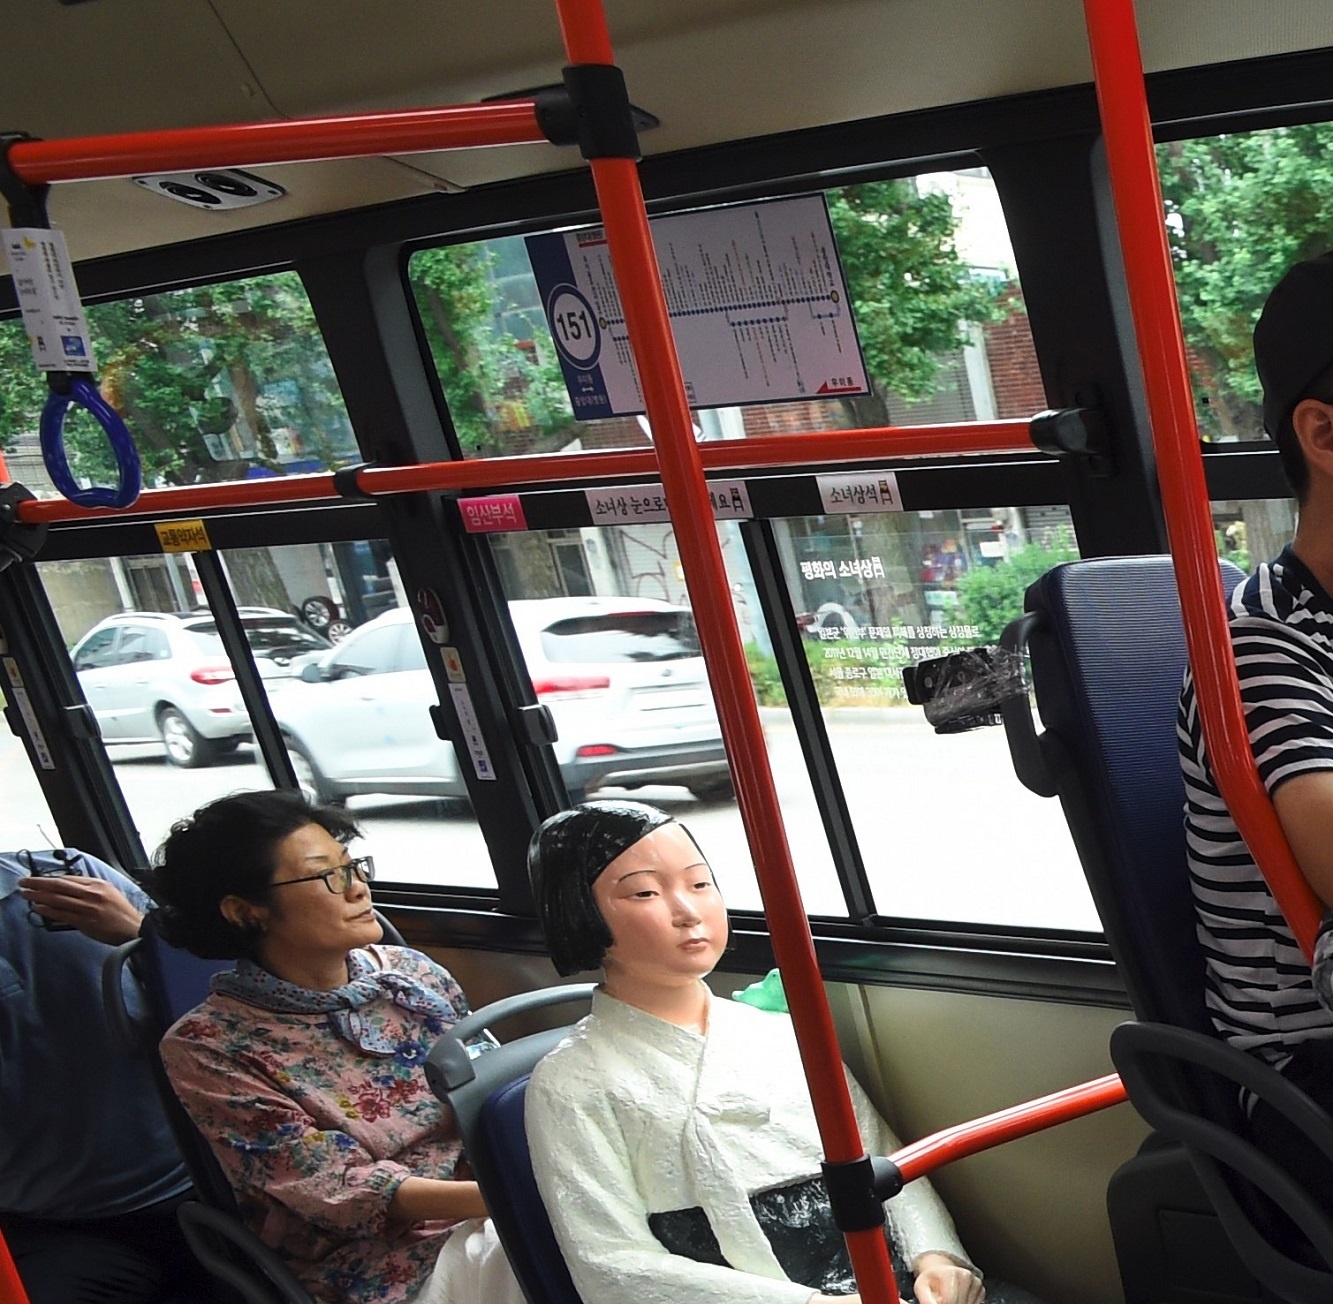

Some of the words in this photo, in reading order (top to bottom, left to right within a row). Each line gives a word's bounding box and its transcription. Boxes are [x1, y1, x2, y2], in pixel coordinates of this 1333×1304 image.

[557, 310, 592, 341] 151
[829, 483, 880, 505] 소녀상석
[466, 503, 516, 527] 임산부석
[595, 496, 628, 517] 소녀상
[630, 496, 669, 515] 눈으로
[159, 526, 207, 548] 교통약자석
[800, 559, 837, 580] 평화의
[838, 558, 874, 579] 소녀상
